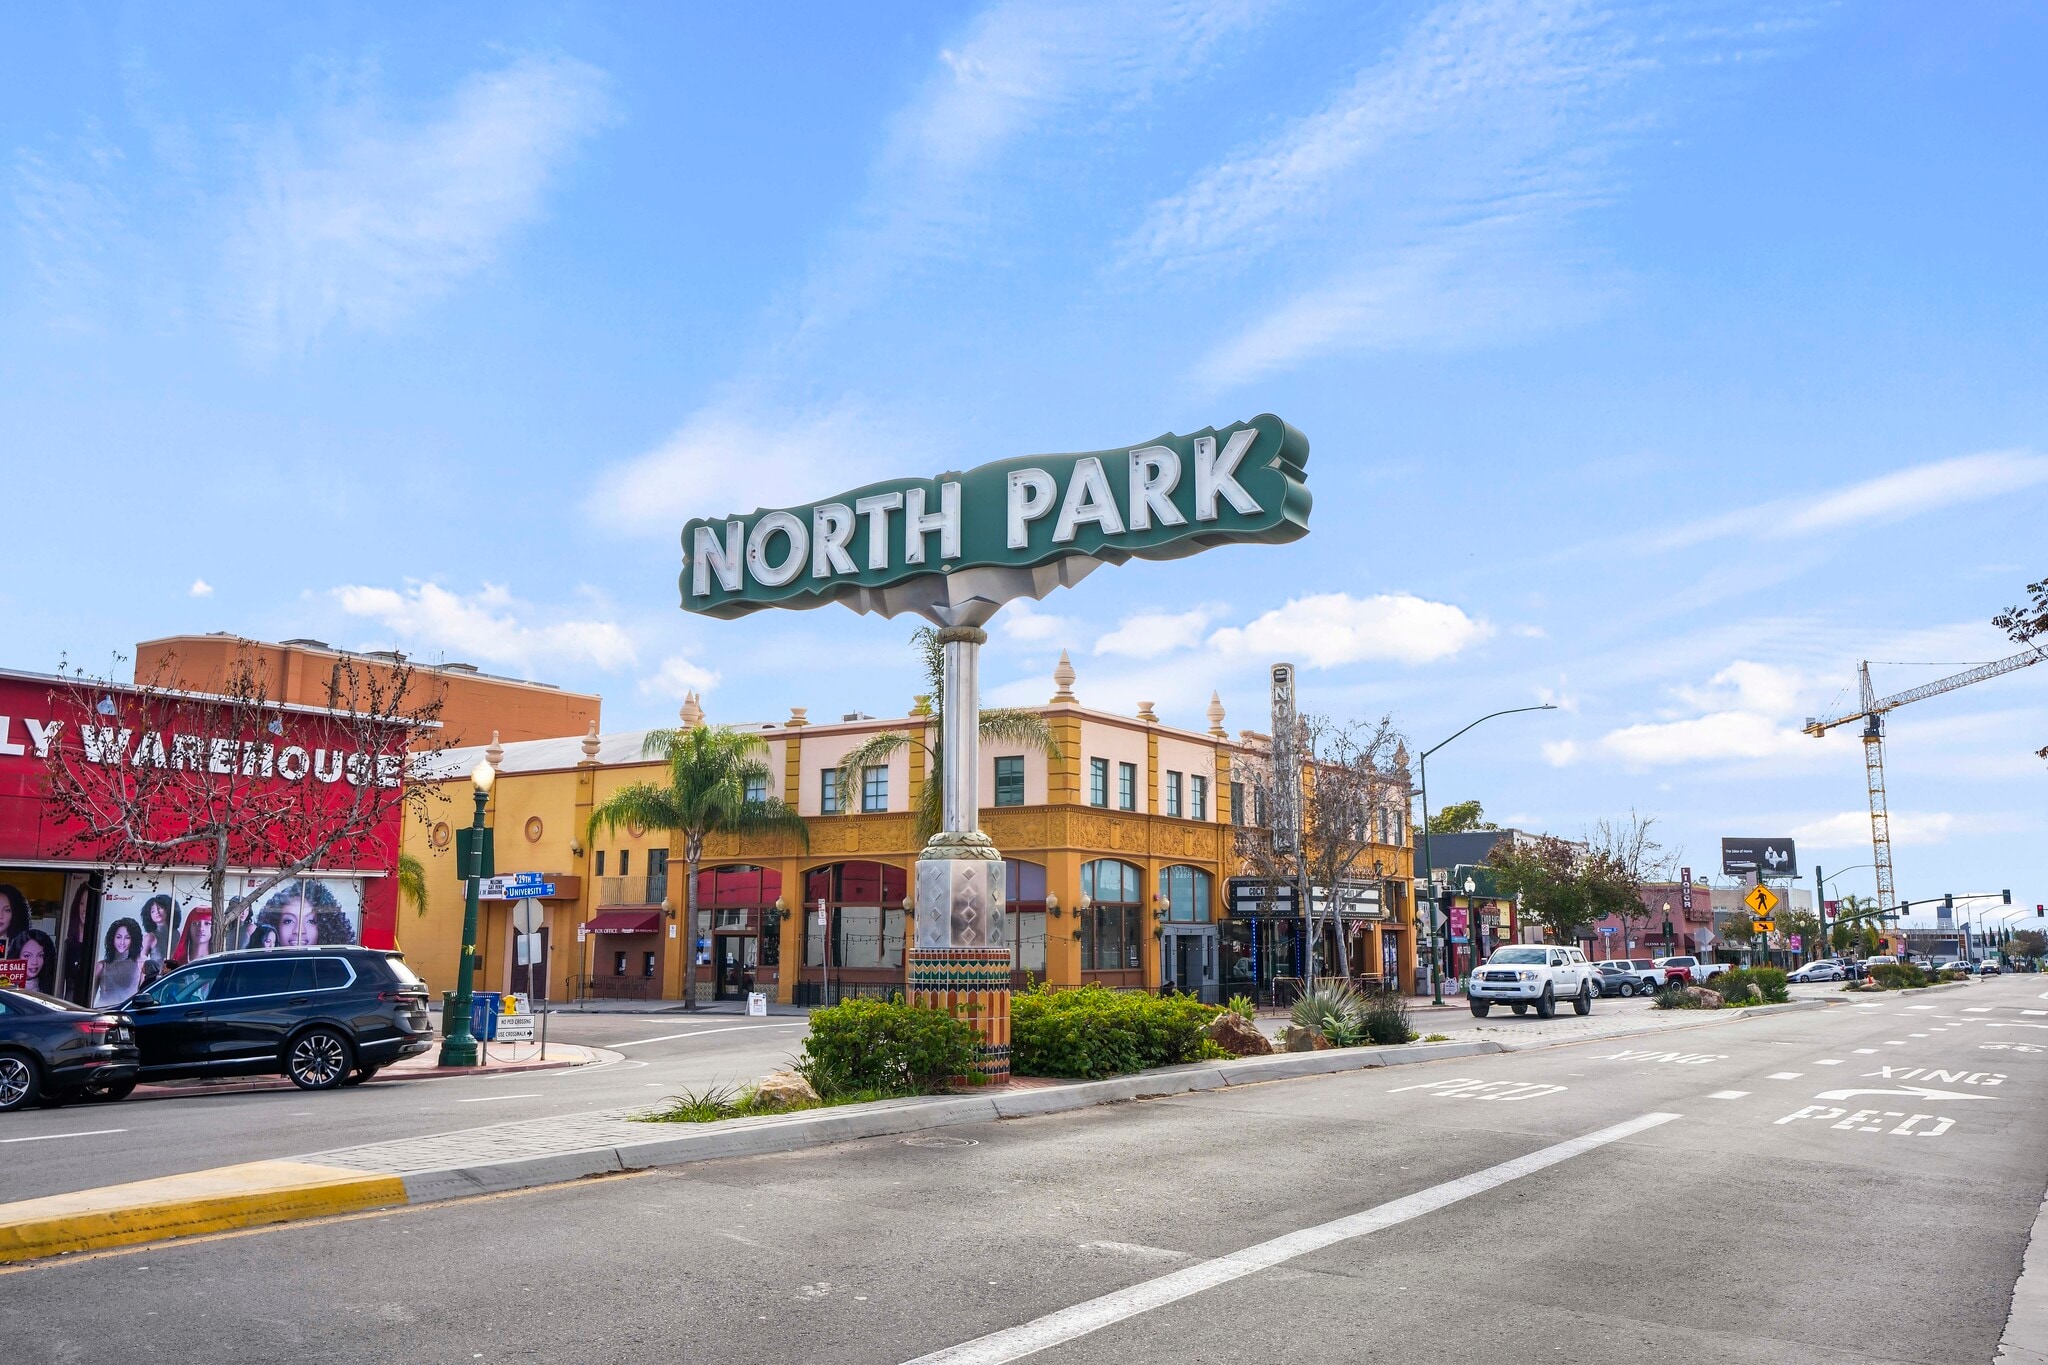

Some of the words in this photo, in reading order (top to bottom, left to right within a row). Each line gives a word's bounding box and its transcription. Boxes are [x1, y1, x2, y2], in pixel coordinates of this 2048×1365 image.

[692, 481, 962, 598] NORTH
[1006, 427, 1267, 550] PARK
[80, 724, 402, 789] WAREHOUSE
[519, 874, 532, 884] 29TH
[1682, 868, 1691, 908] LIQUOR
[509, 887, 542, 897] UNIVERSITY
[9, 963, 26, 971] SALE
[1859, 1065, 2008, 1086] XING
[1385, 1078, 1568, 1101] PED
[1773, 1105, 1957, 1137] PED
